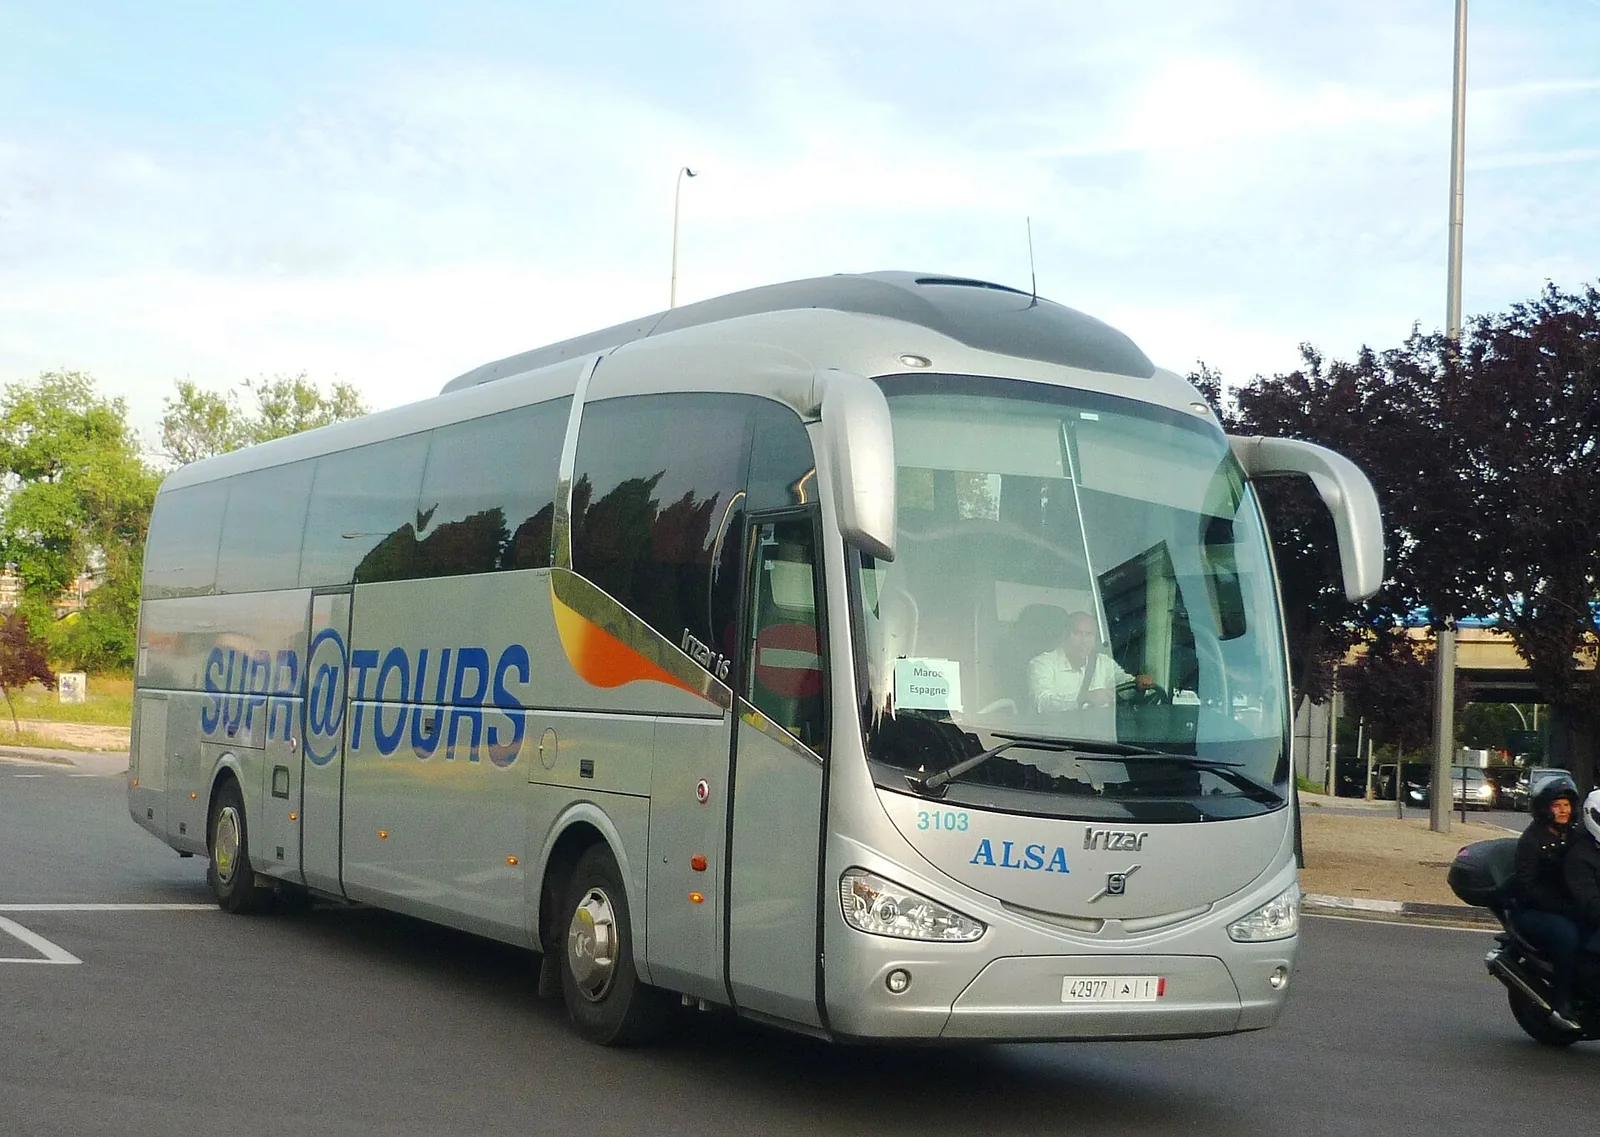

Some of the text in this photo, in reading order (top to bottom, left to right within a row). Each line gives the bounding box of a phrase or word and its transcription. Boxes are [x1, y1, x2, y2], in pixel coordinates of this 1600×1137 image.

[913, 667, 944, 678] Maroc
[909, 684, 947, 697] Espagne
[916, 810, 969, 832] 3103
[969, 838, 1071, 875] ALSA
[1070, 980, 1108, 998] 42977
